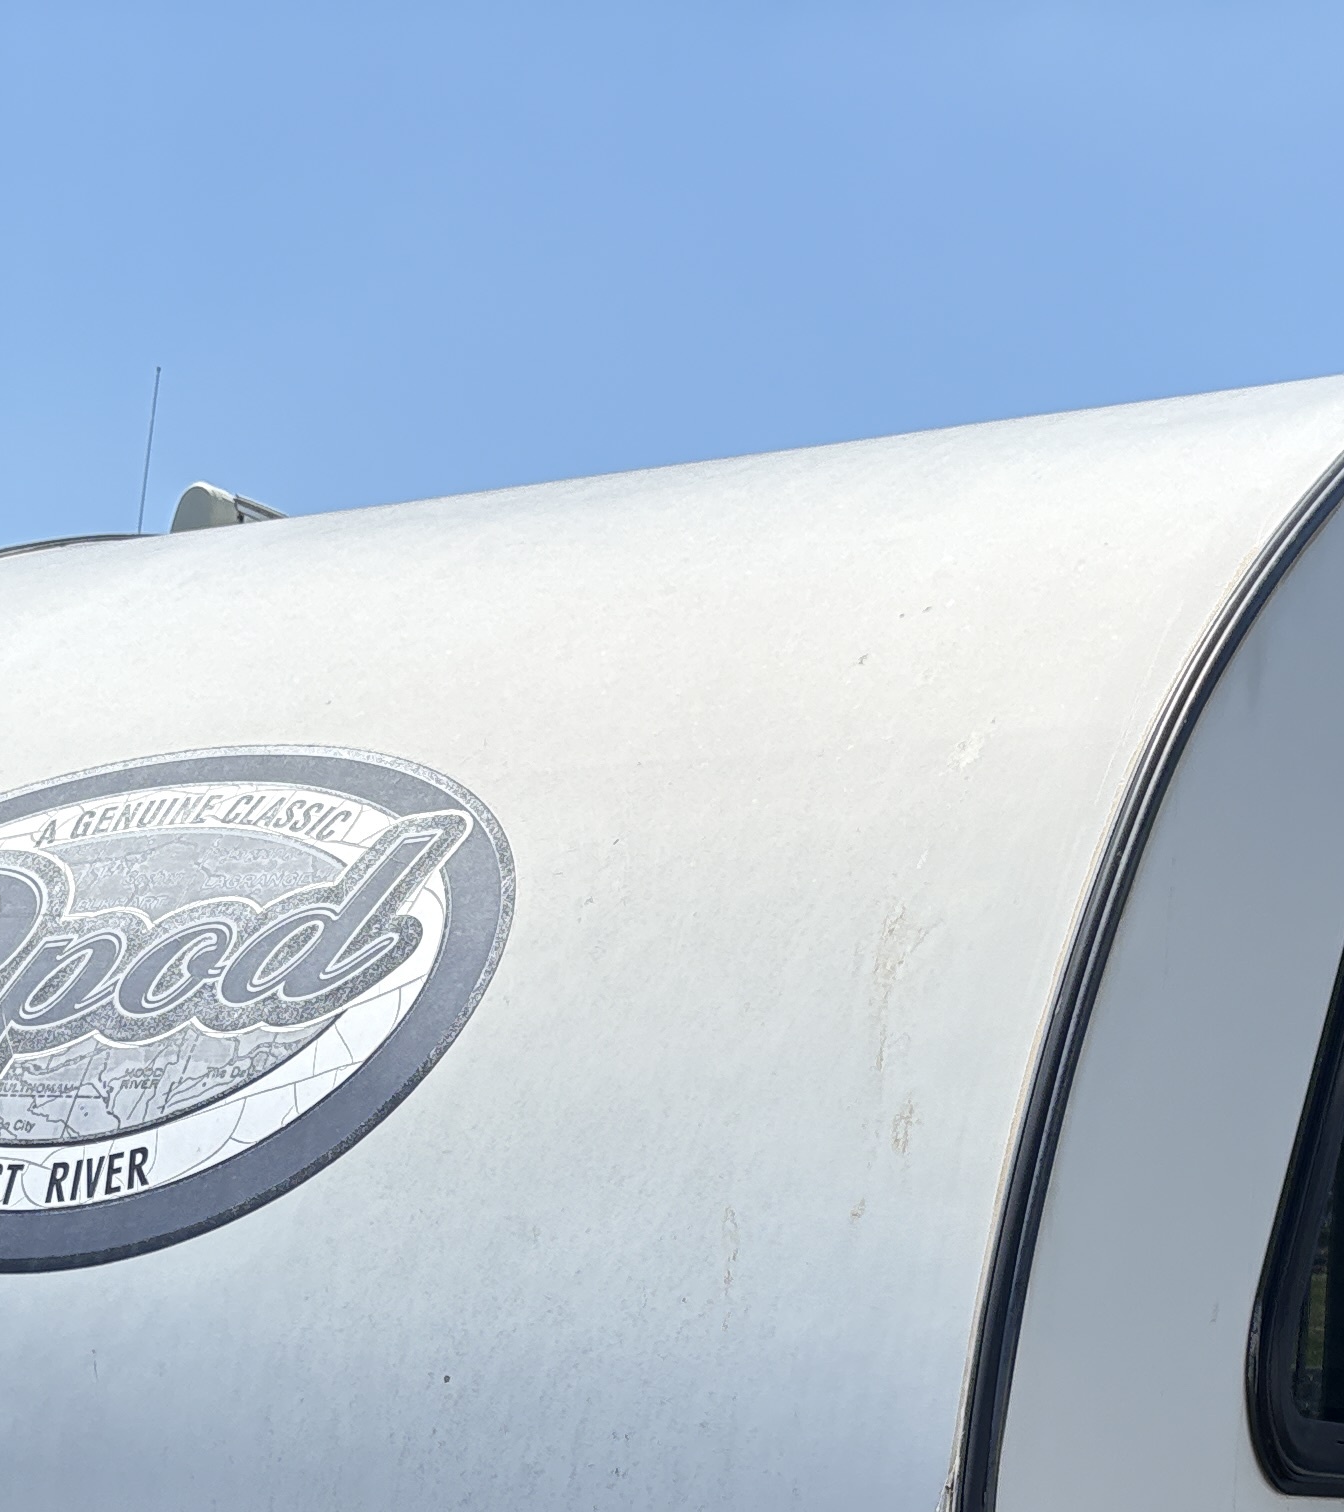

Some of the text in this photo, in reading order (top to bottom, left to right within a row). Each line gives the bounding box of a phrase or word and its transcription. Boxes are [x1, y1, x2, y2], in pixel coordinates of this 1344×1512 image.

[34, 794, 352, 847] A GENUINE CLASSIC
[44, 1145, 150, 1204] RIVER
